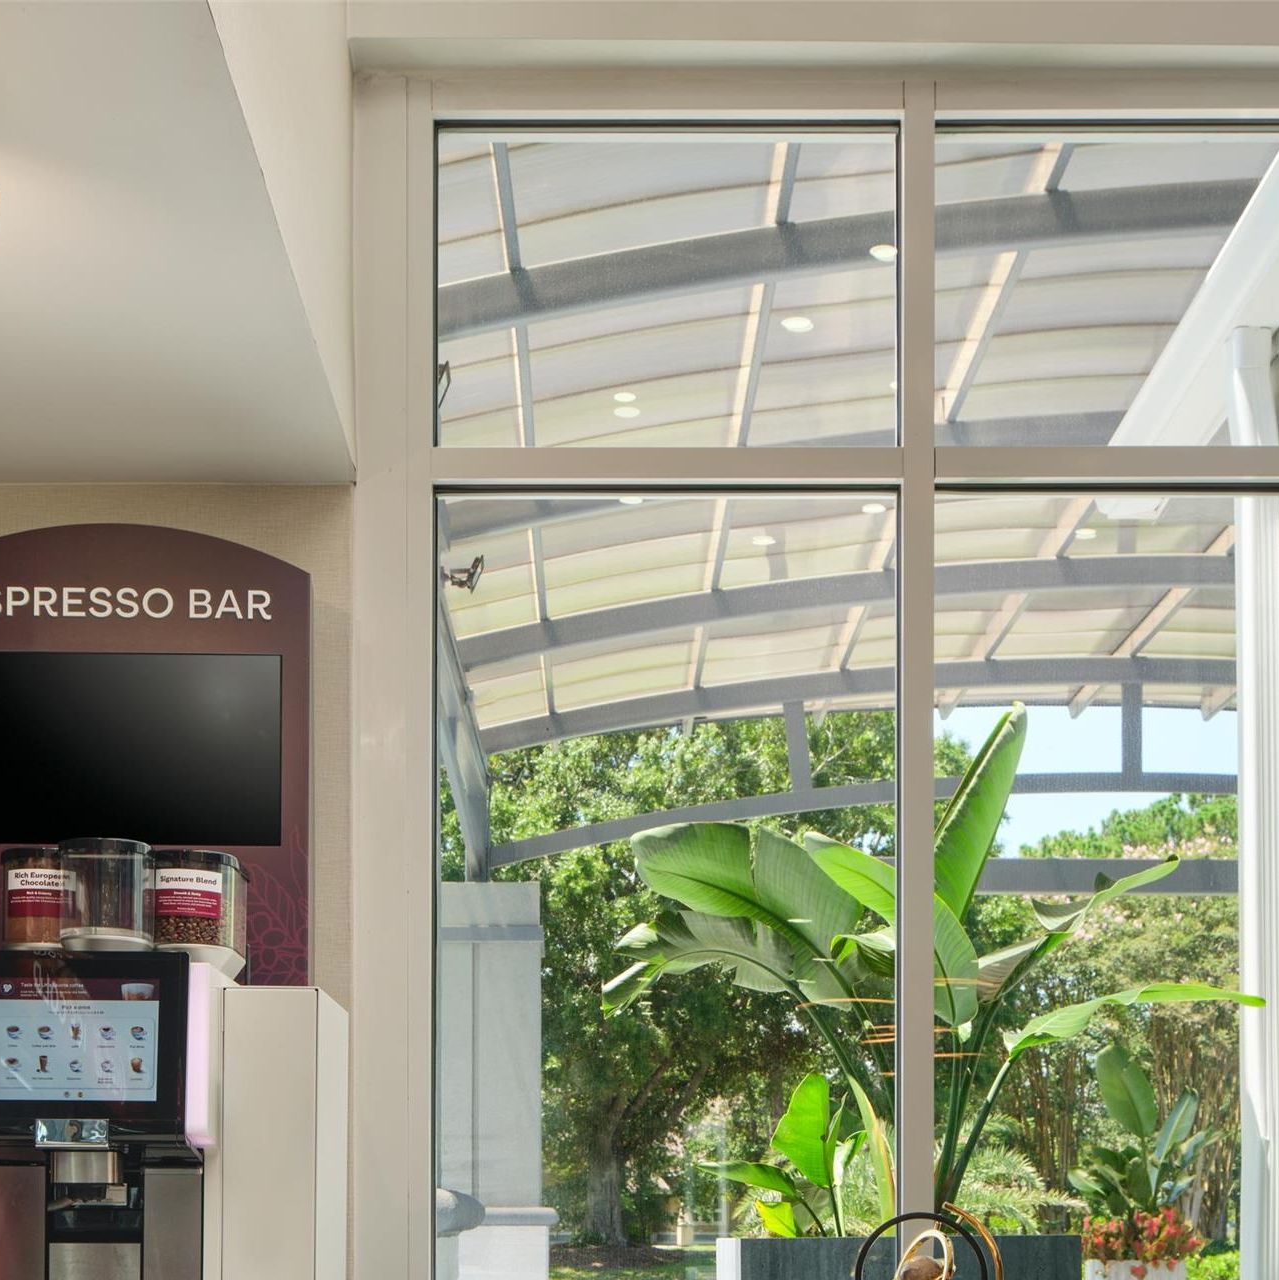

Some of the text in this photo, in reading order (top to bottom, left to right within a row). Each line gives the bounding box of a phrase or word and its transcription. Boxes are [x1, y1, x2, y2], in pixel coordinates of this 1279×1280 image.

[188, 588, 273, 622] BAR
[20, 879, 59, 887] Chocolate
[160, 875, 218, 886] Signature Blend
